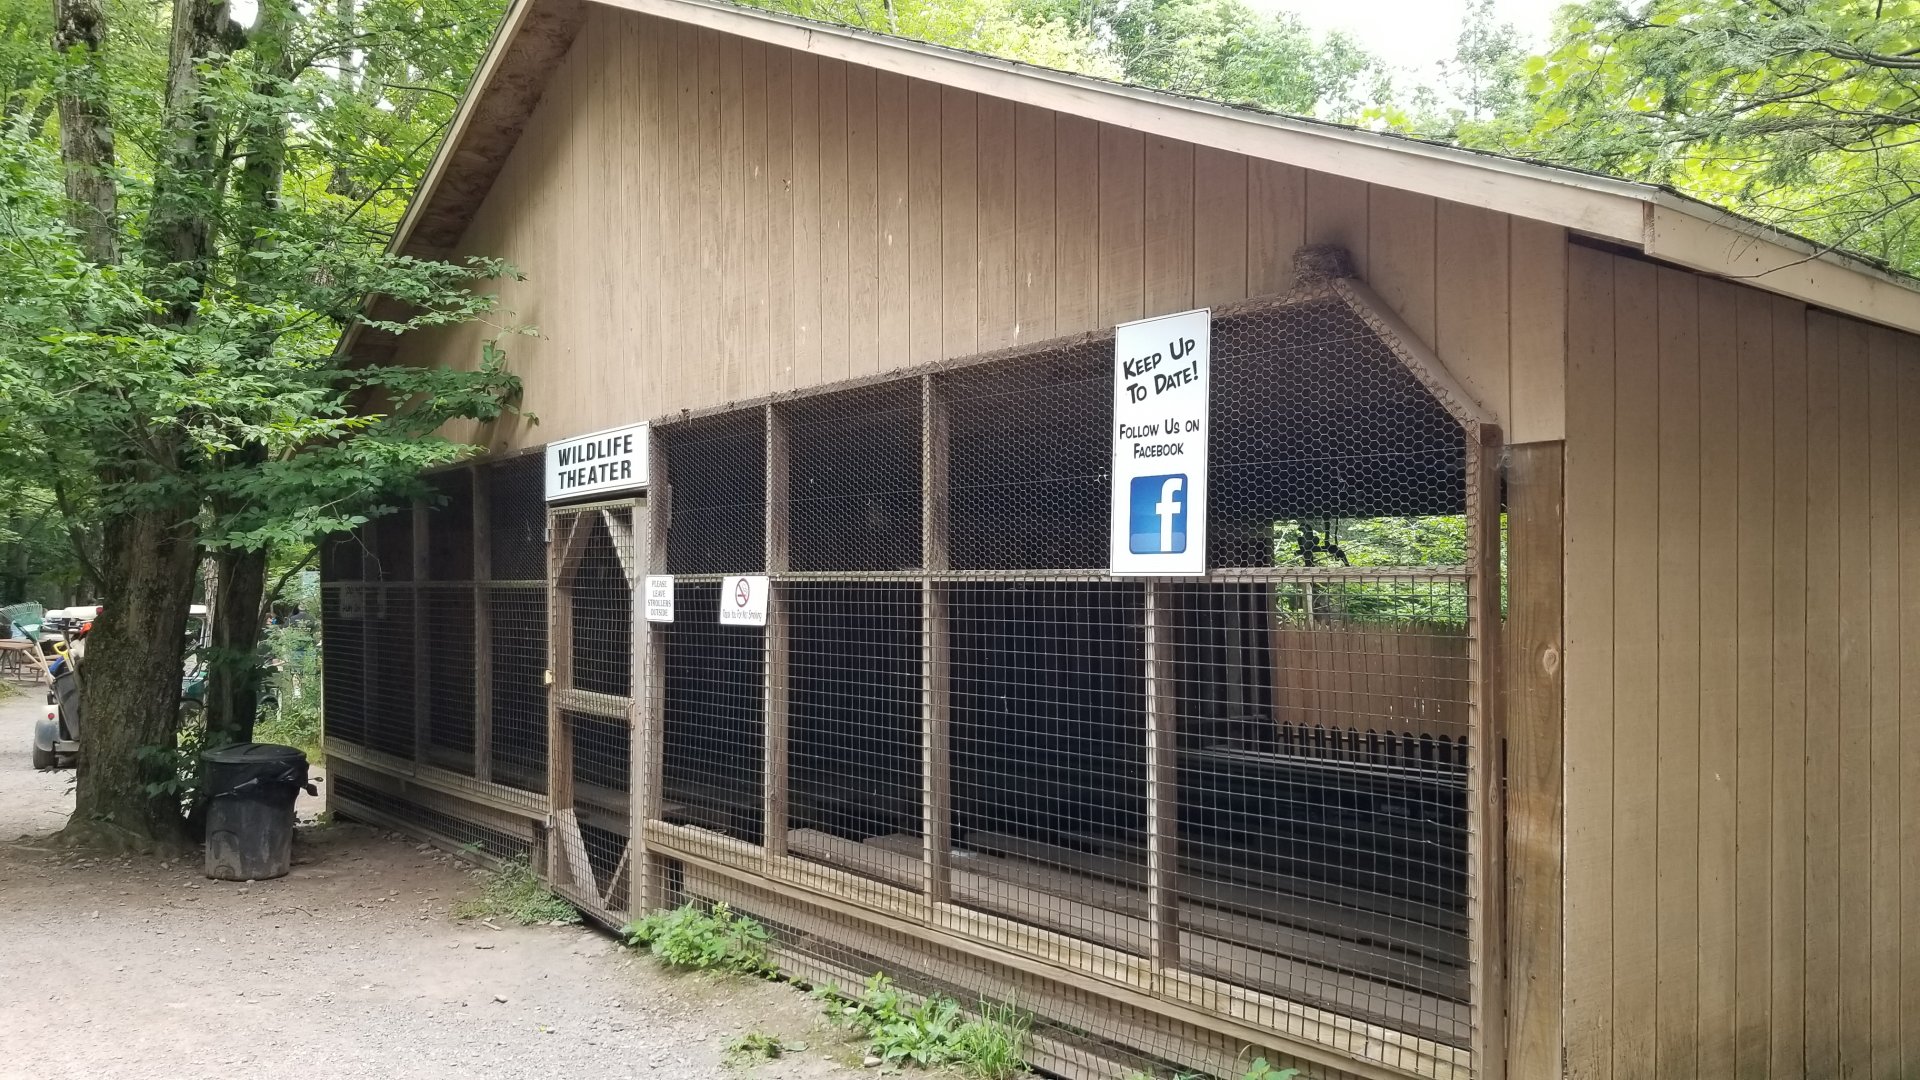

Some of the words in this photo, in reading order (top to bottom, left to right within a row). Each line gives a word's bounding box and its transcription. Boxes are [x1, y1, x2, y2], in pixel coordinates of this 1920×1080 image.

[1123, 352, 1162, 380] KEEP
[1169, 337, 1196, 361] UP
[1126, 382, 1148, 404] TO
[1153, 360, 1199, 396] DATE!
[1119, 423, 1160, 440] FOLLOW
[1164, 417, 1180, 435] US
[1185, 418, 1200, 433] ON
[558, 433, 633, 467] WILDLIFE
[1133, 442, 1184, 459] FACEBOOK
[558, 459, 632, 490] THEATER
[651, 580, 668, 588] PLEASE
[652, 590, 666, 598] LEAVE
[647, 599, 672, 607] STROLLERS
[651, 608, 668, 616] OUTSIDE
